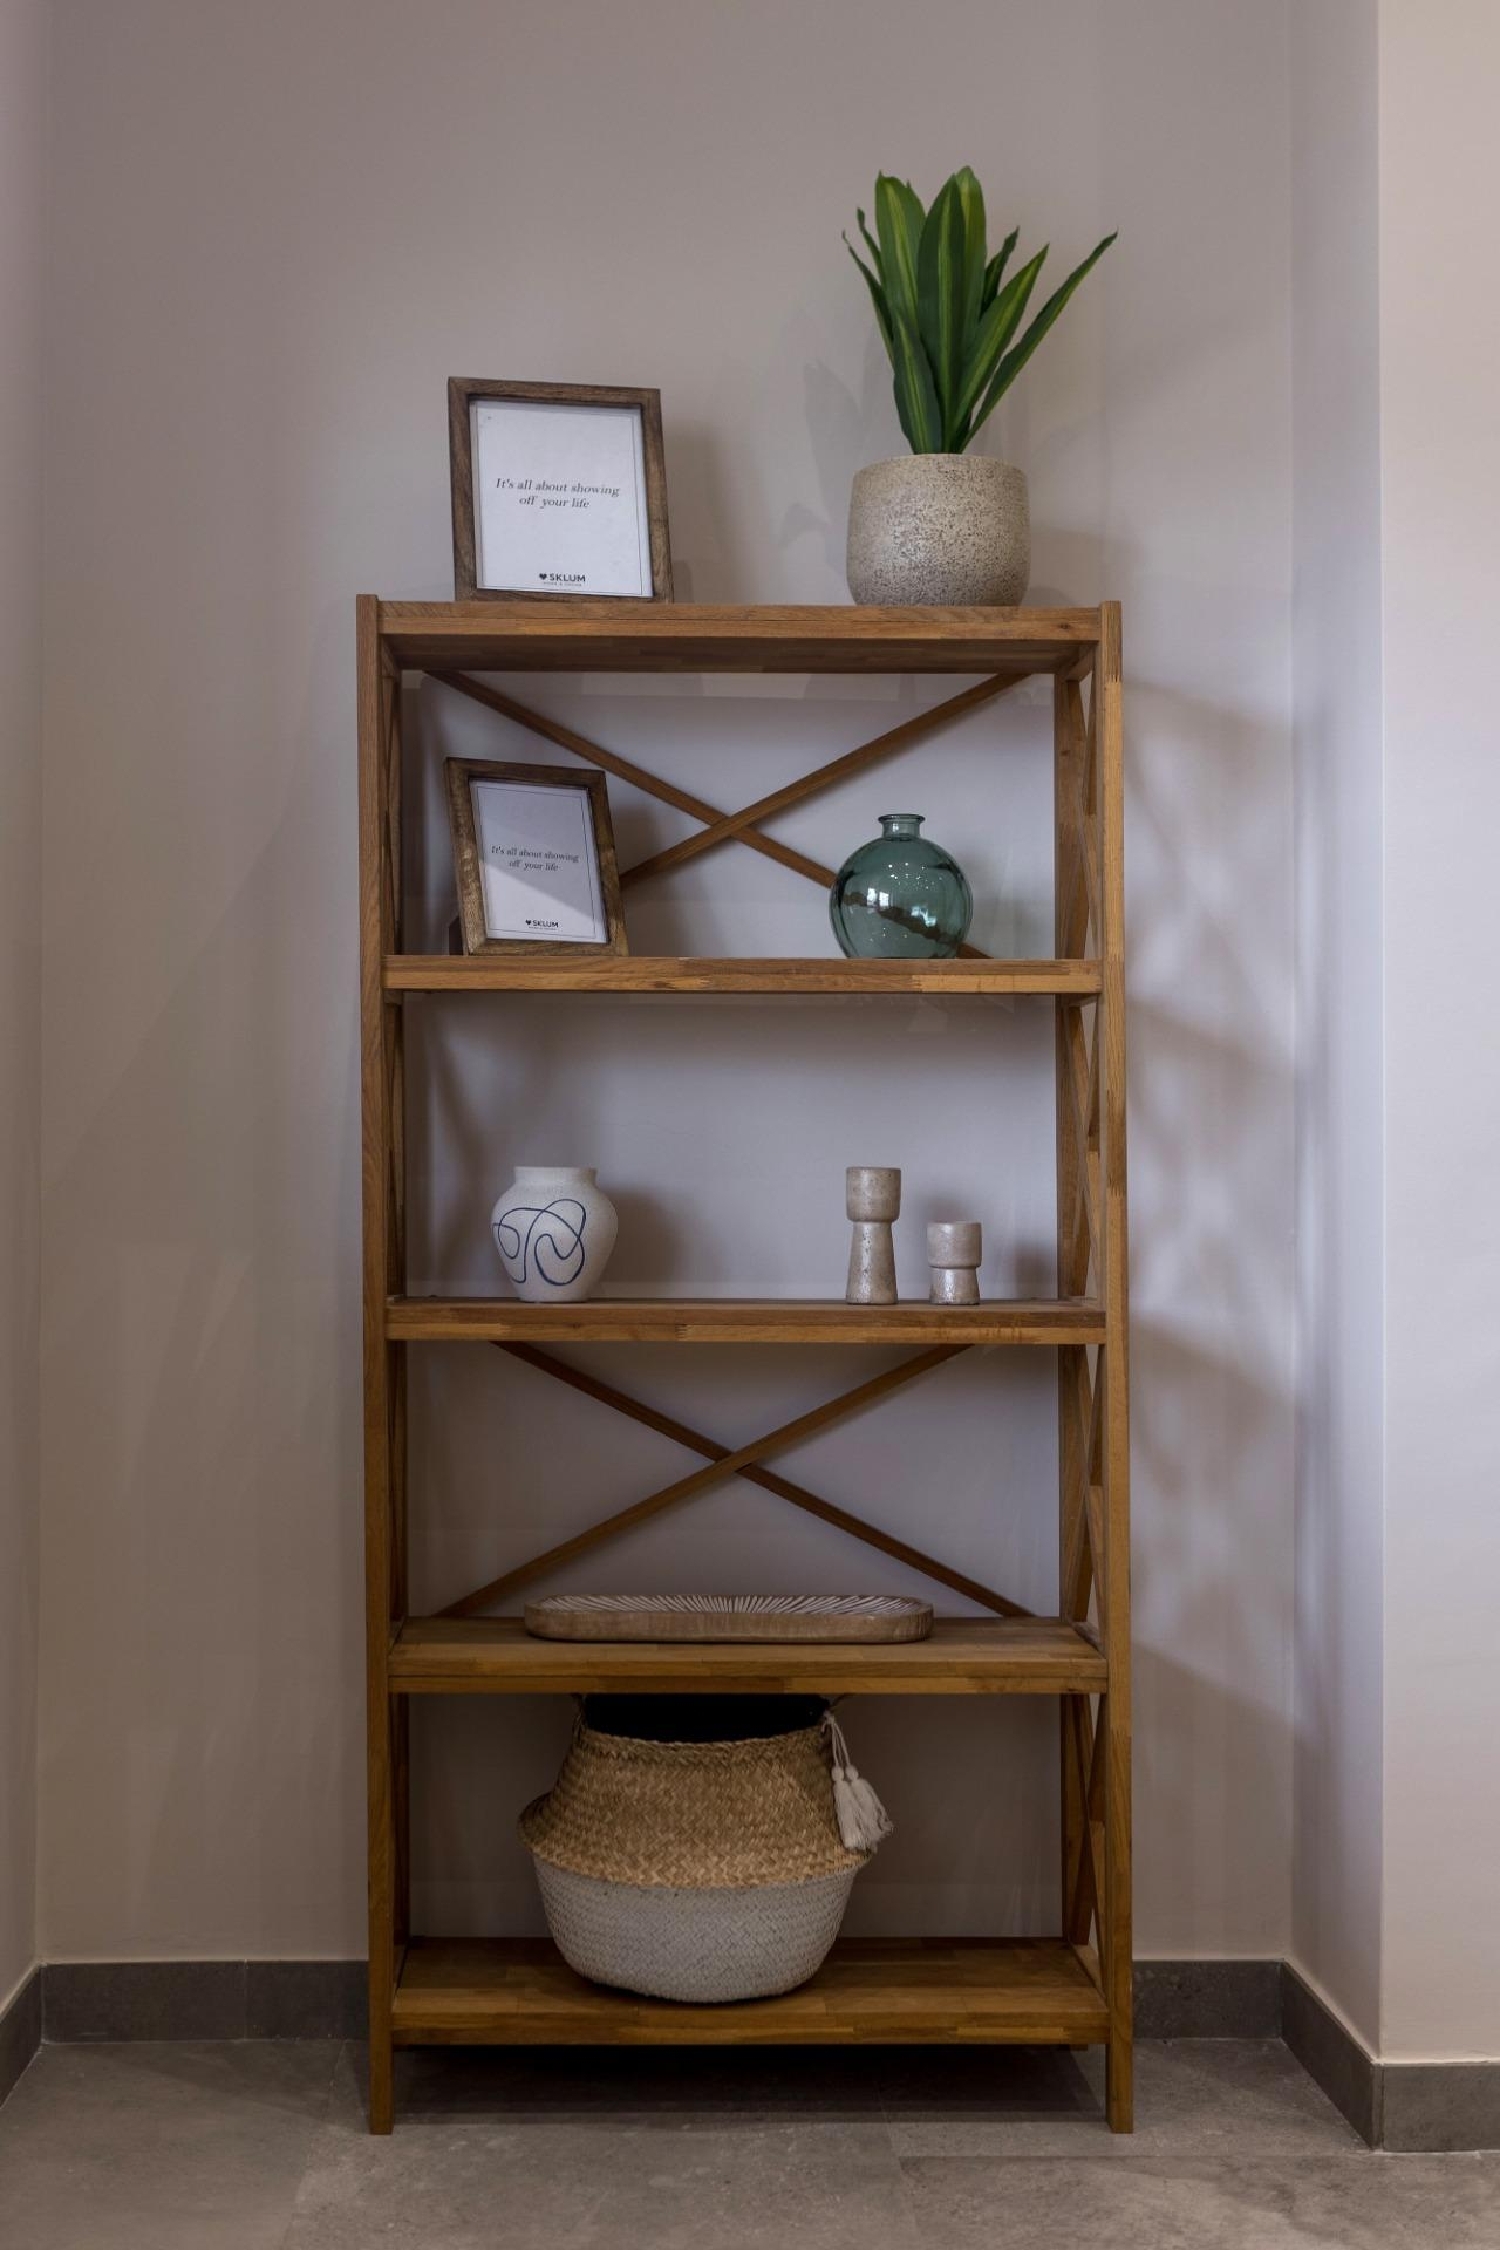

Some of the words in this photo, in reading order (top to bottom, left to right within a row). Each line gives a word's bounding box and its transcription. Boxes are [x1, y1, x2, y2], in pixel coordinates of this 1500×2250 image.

[496, 477, 514, 489] It's
[517, 479, 532, 490] all
[535, 480, 567, 492] about
[570, 482, 620, 498] showing
[519, 495, 538, 506] off
[539, 499, 568, 510] your
[571, 497, 590, 508] life
[549, 573, 586, 582] SKLUM
